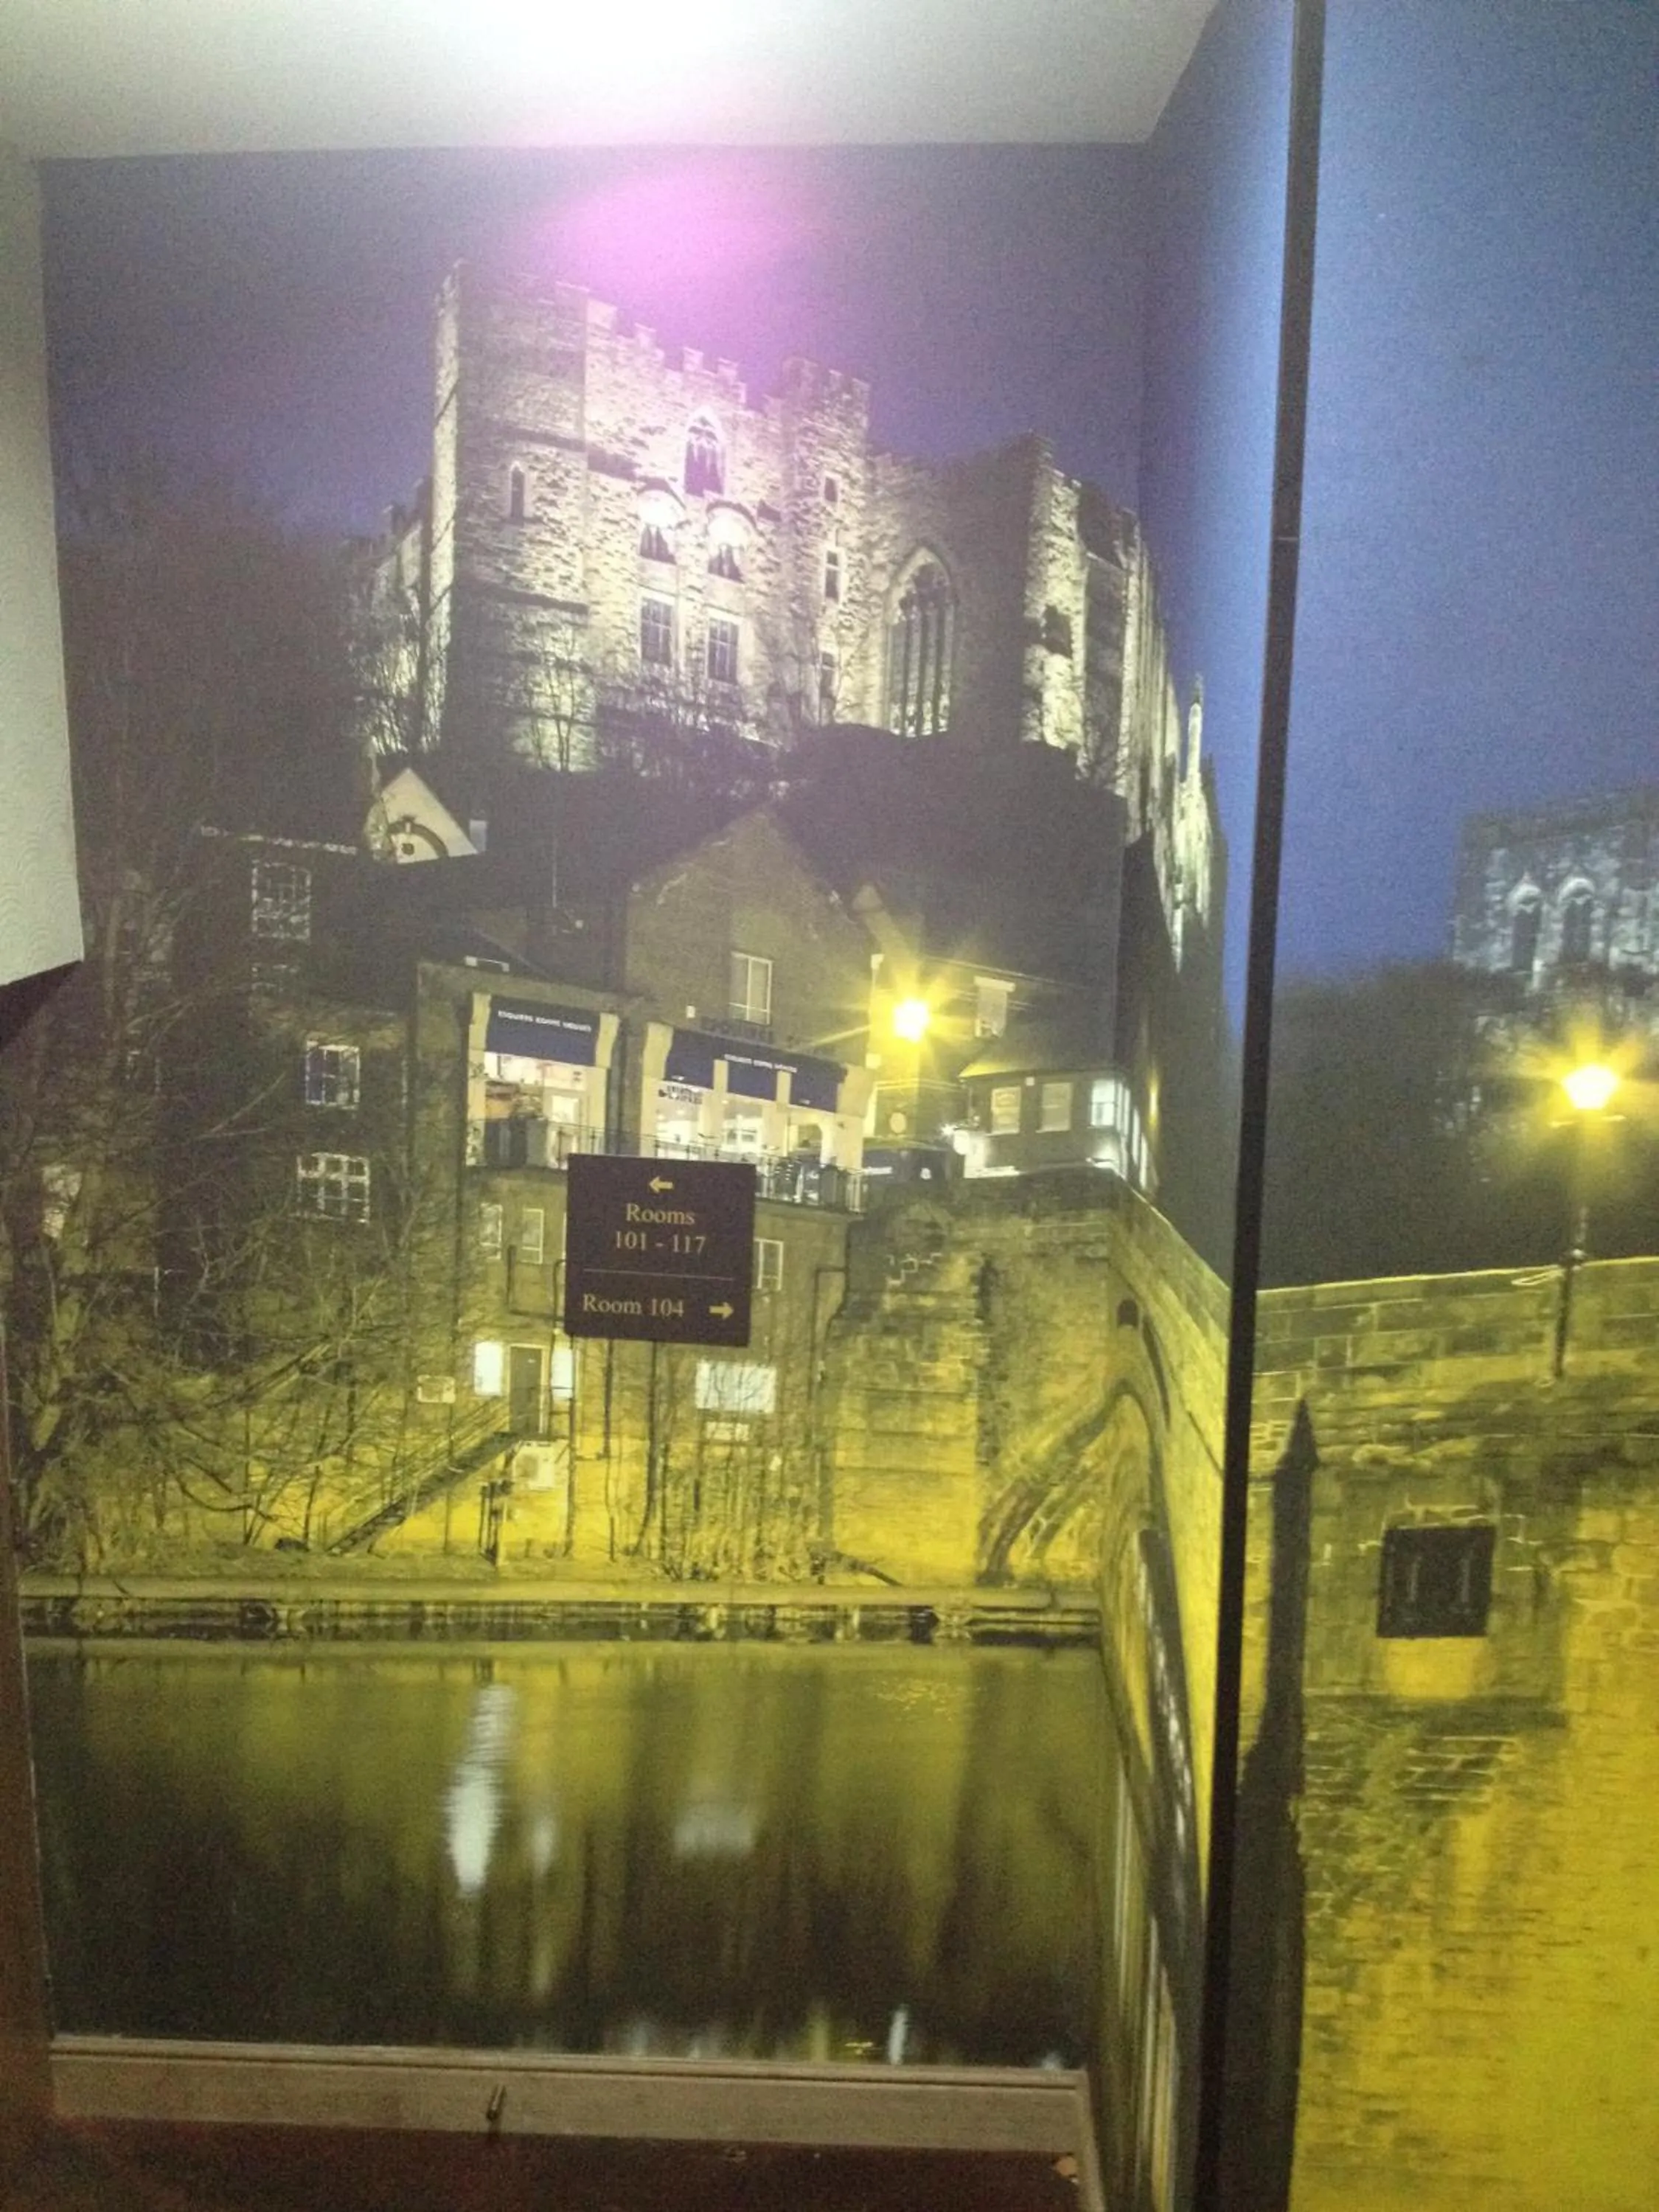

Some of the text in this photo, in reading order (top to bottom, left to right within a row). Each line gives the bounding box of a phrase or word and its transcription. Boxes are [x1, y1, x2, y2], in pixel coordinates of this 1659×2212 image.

[626, 1203, 695, 1225] Rooms
[615, 1230, 647, 1251] 101
[672, 1234, 706, 1253] 117
[582, 1293, 684, 1318] Room 104
